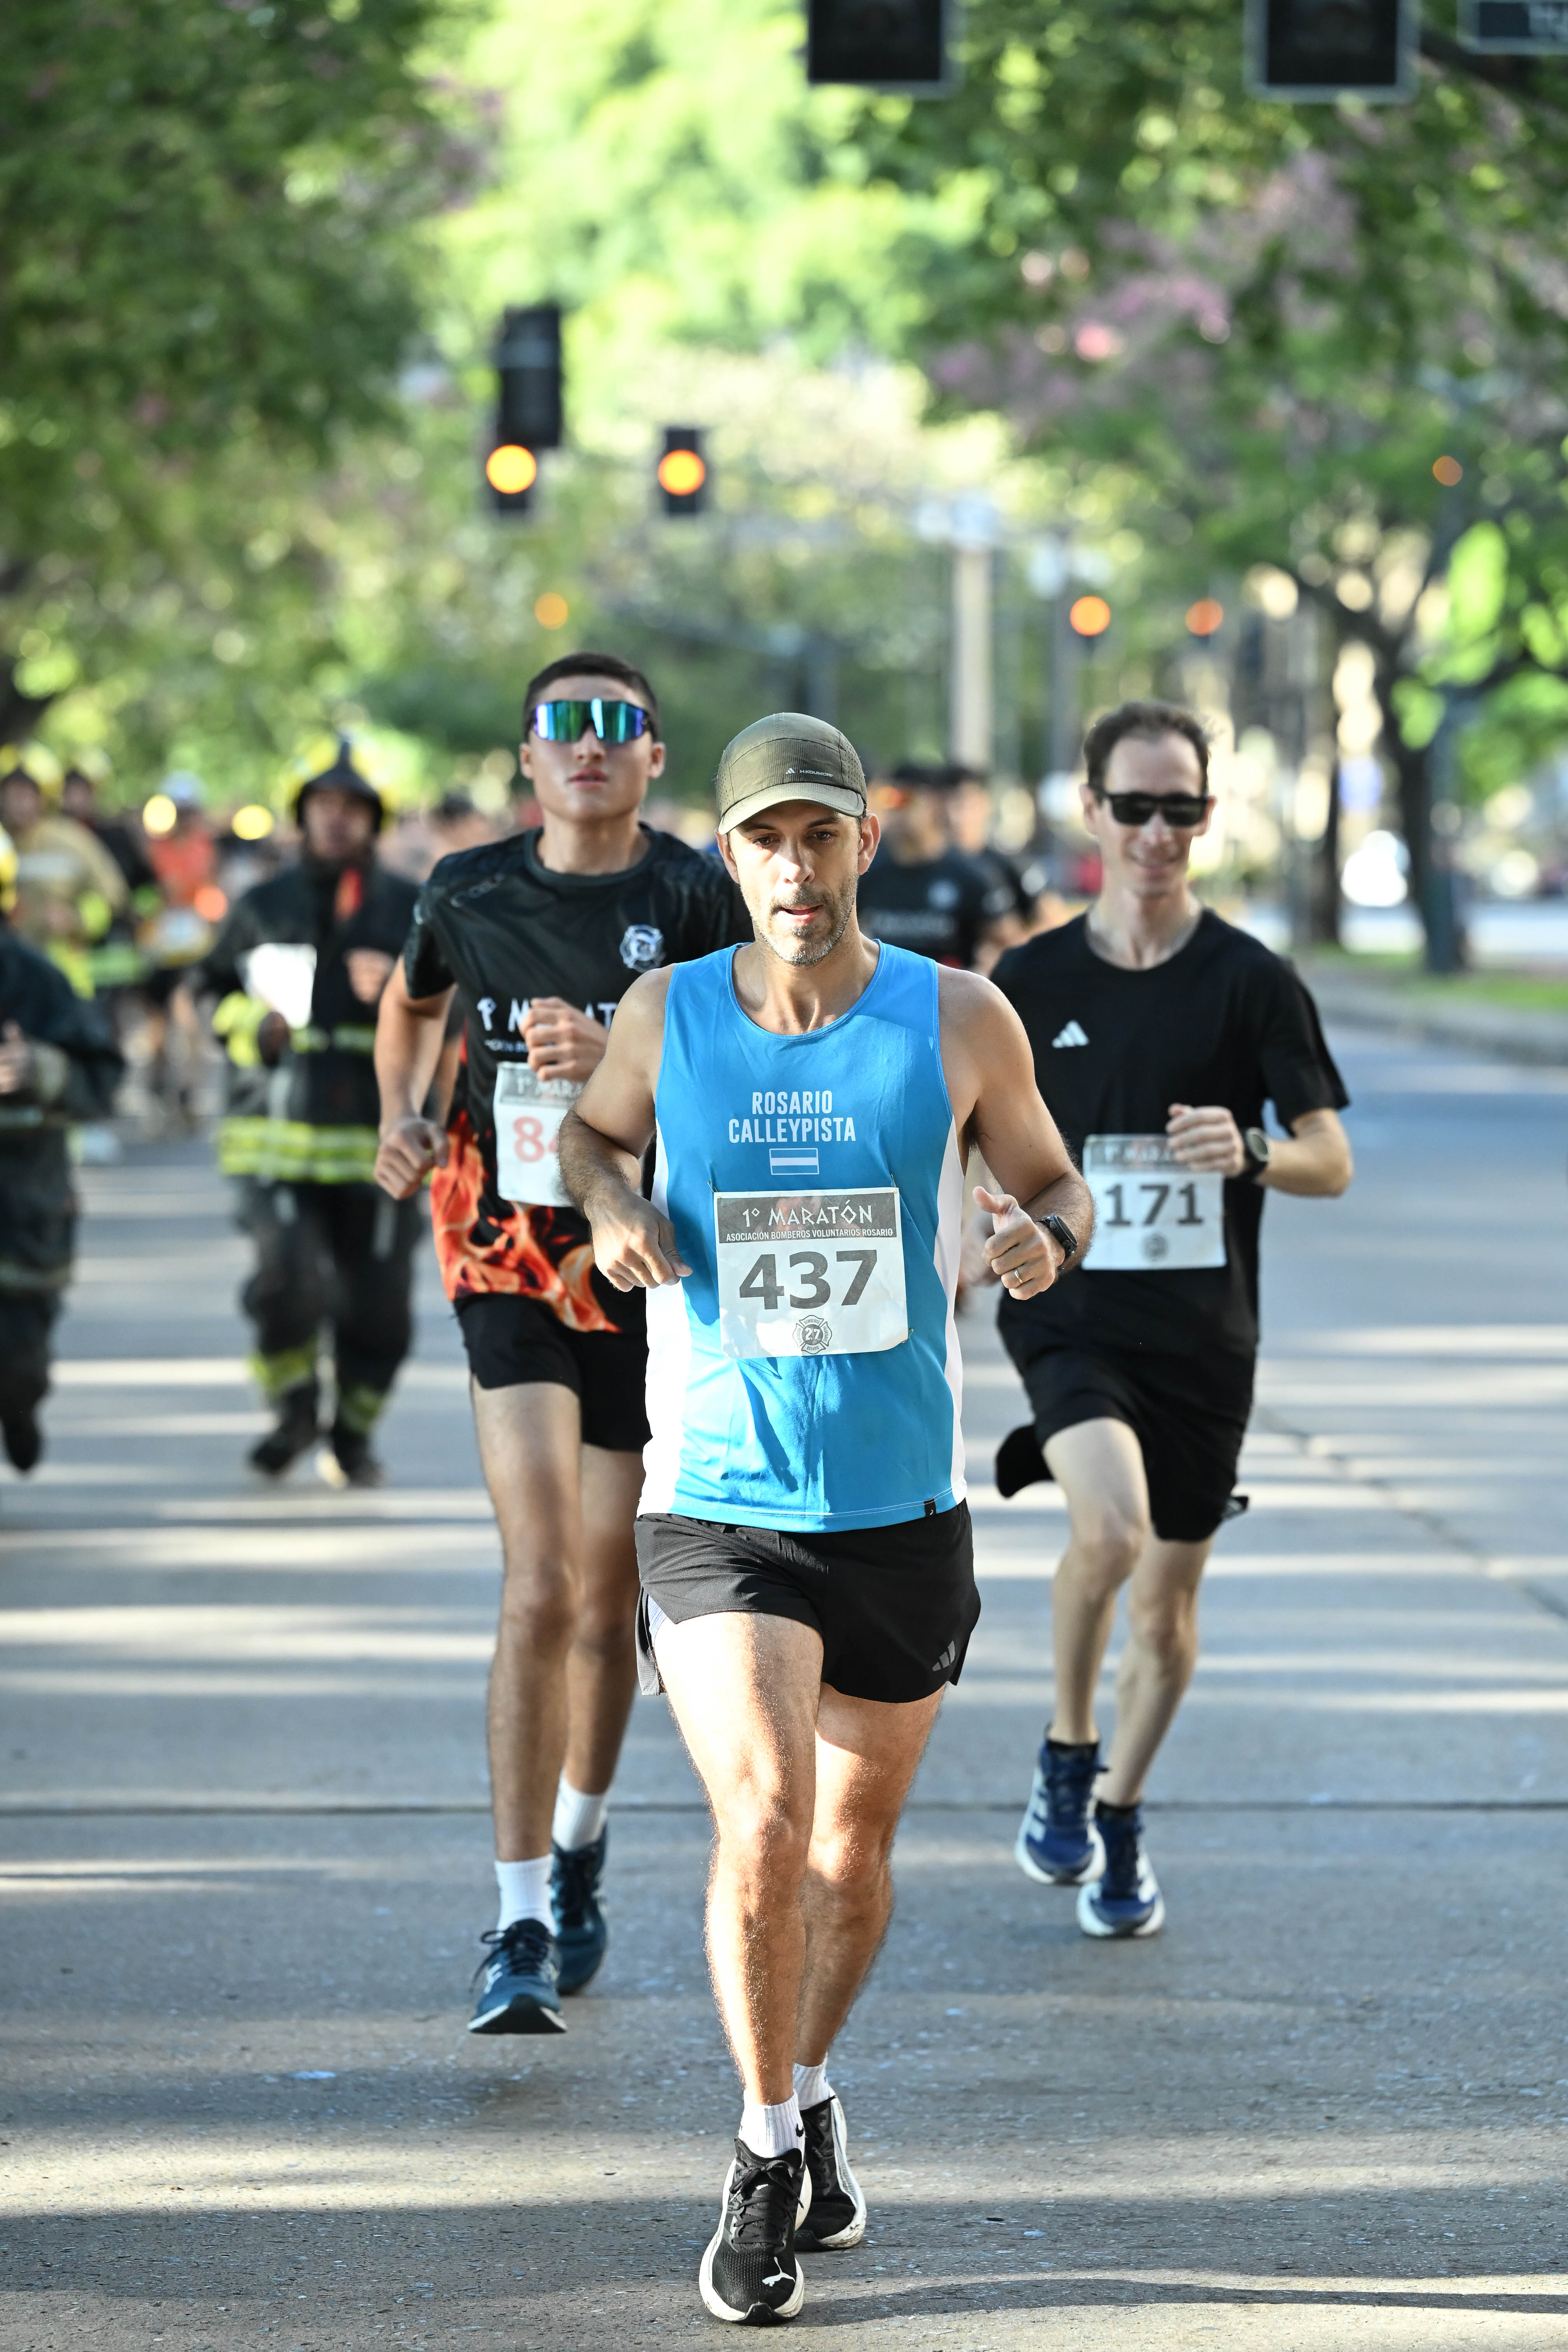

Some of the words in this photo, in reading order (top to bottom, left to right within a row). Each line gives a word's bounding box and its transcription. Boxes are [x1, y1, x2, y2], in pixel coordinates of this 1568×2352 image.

[752, 1090, 832, 1115] ROSARIO
[729, 1117, 856, 1143] CALLEYPISTA
[768, 1200, 872, 1226] MARATÓN
[1105, 1182, 1204, 1227] 171
[726, 1230, 769, 1242] ASOCIACIÓN
[771, 1230, 810, 1239] BOMBEROS
[812, 1228, 861, 1237] VOLUNTARIOS
[862, 1228, 893, 1237] ROSARIO
[739, 1250, 877, 1309] 437
[805, 1327, 820, 1340] 27
